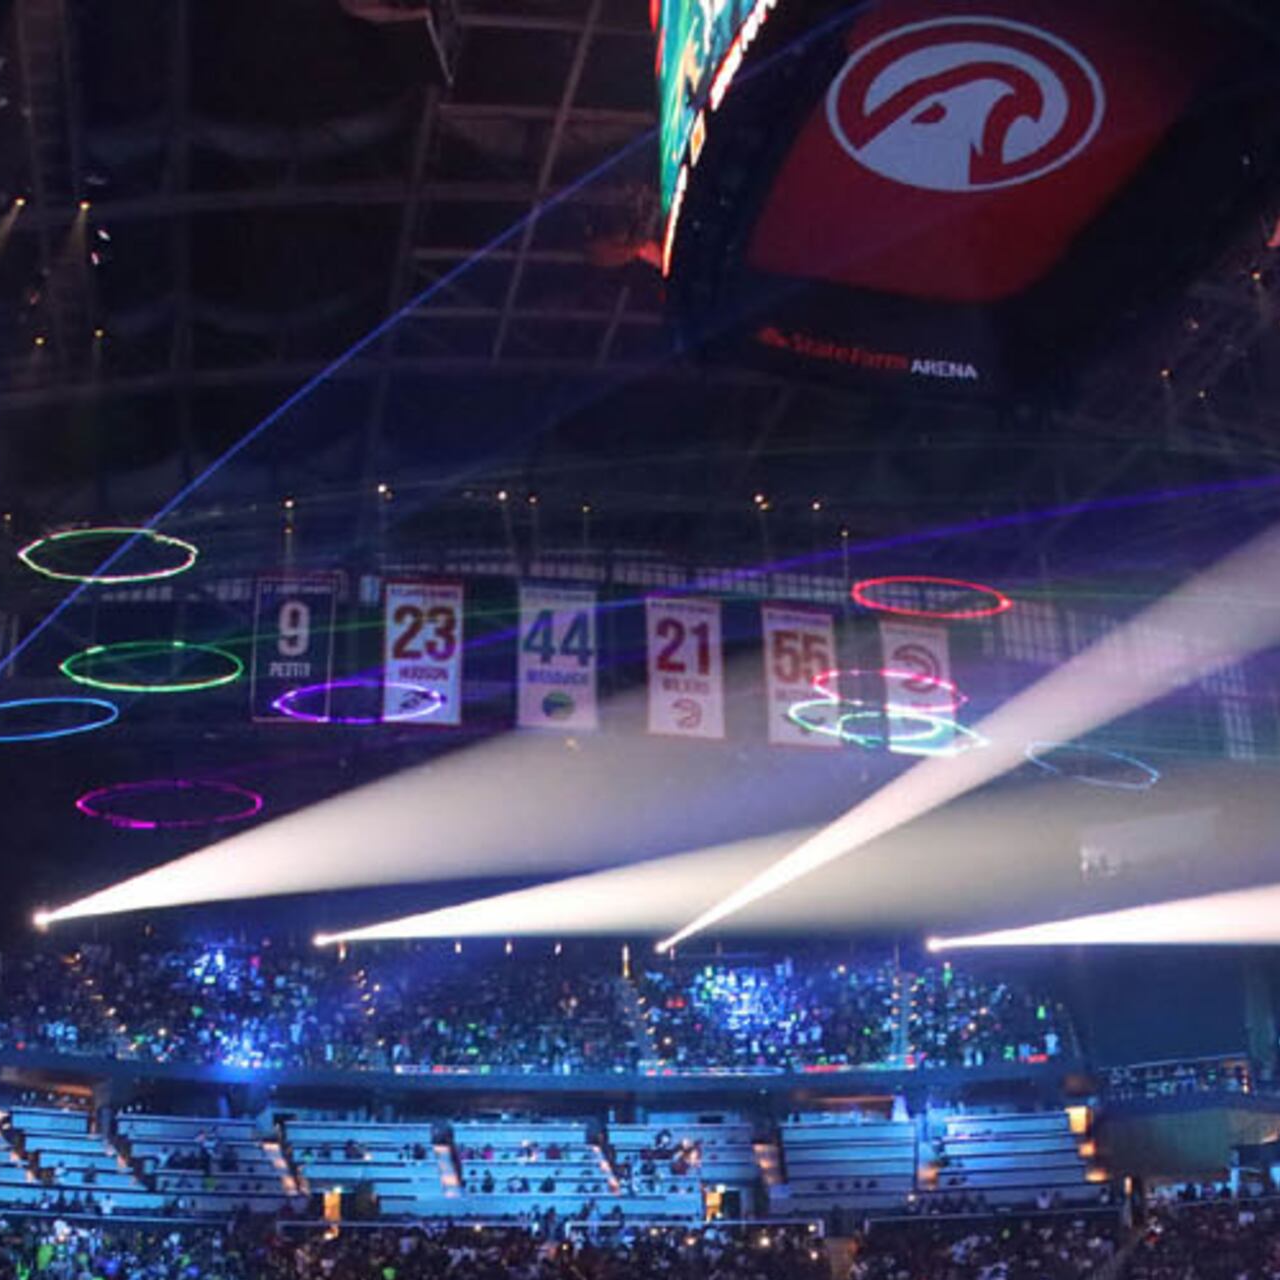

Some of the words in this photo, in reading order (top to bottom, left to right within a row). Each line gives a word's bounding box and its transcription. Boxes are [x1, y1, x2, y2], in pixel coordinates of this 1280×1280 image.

[911, 358, 978, 379] ARENA
[278, 600, 310, 657] 9
[393, 605, 457, 662] 23
[523, 608, 593, 667] 44
[656, 617, 710, 676] 21
[773, 630, 829, 684] 55
[398, 665, 450, 682] HUDSON
